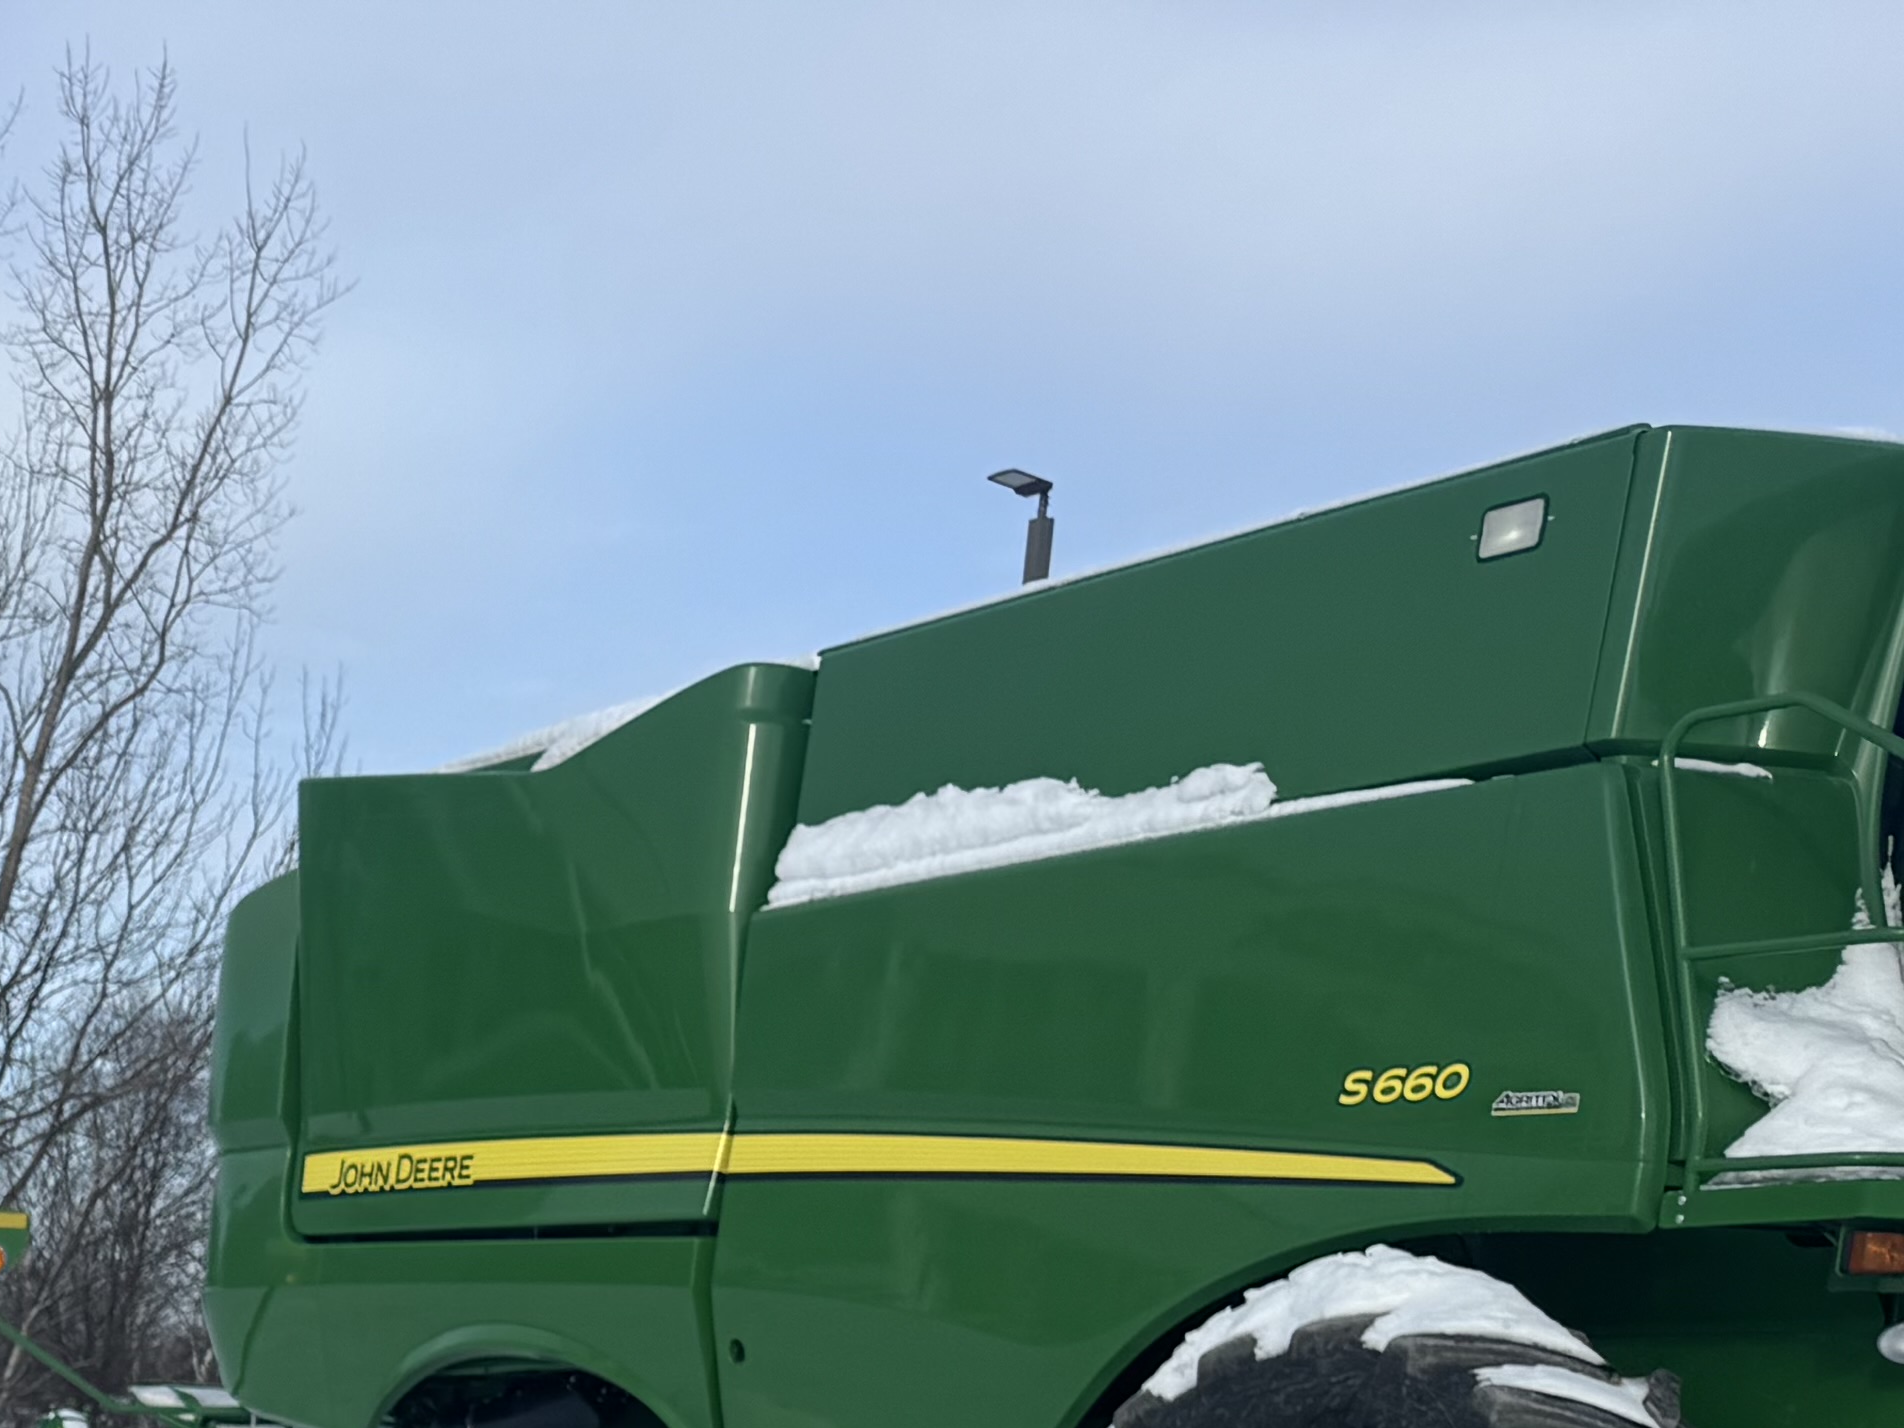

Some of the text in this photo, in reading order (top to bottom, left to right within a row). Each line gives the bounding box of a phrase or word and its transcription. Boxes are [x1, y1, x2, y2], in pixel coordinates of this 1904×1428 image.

[1338, 1063, 1471, 1106] S660
[329, 1153, 475, 1190] JOHN DEERE
